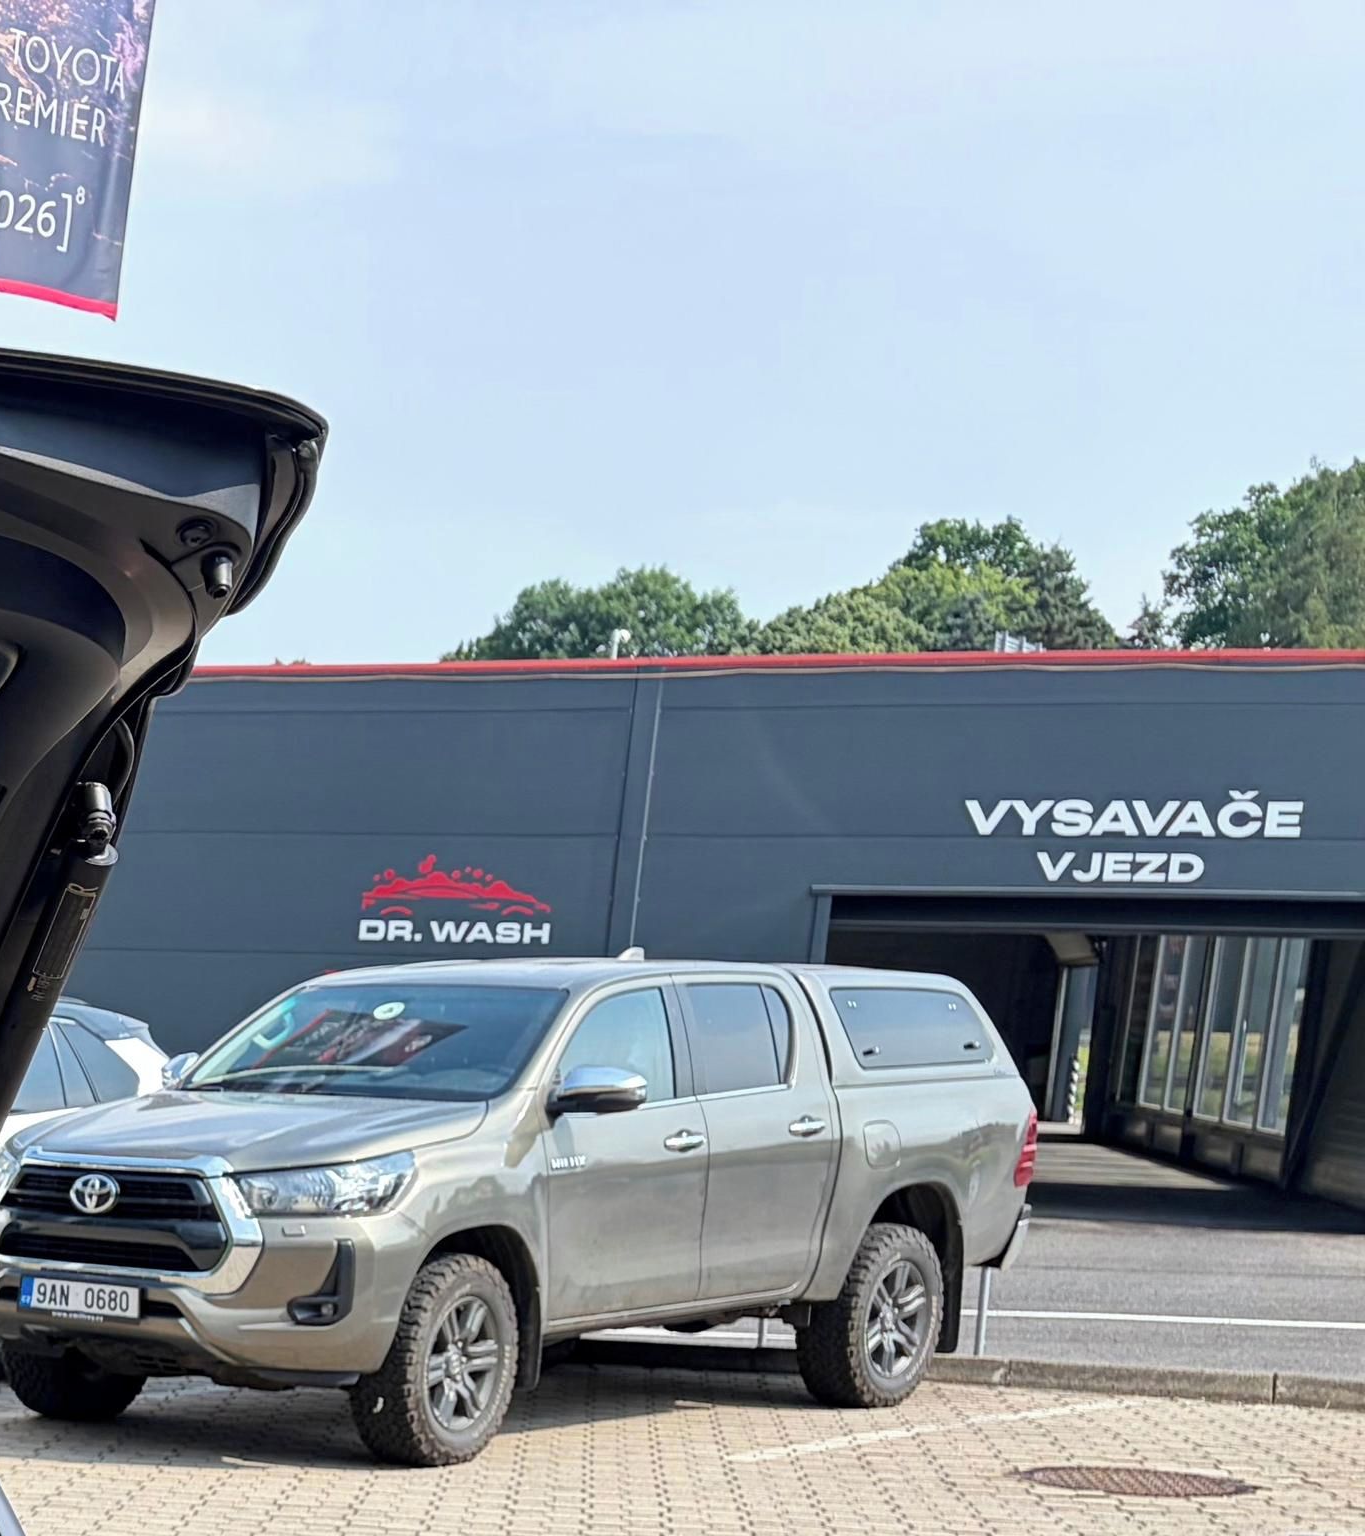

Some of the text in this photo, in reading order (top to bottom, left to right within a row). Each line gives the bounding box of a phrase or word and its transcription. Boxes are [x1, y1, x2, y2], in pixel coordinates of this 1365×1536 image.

[10, 27, 125, 100] TOYOTA
[964, 790, 1305, 838] VYSAVAČE
[1037, 851, 1205, 883] VJEZD
[358, 919, 551, 944] DR. WASH
[35, 1282, 70, 1307] 9AN
[84, 1287, 129, 1313] 0680
